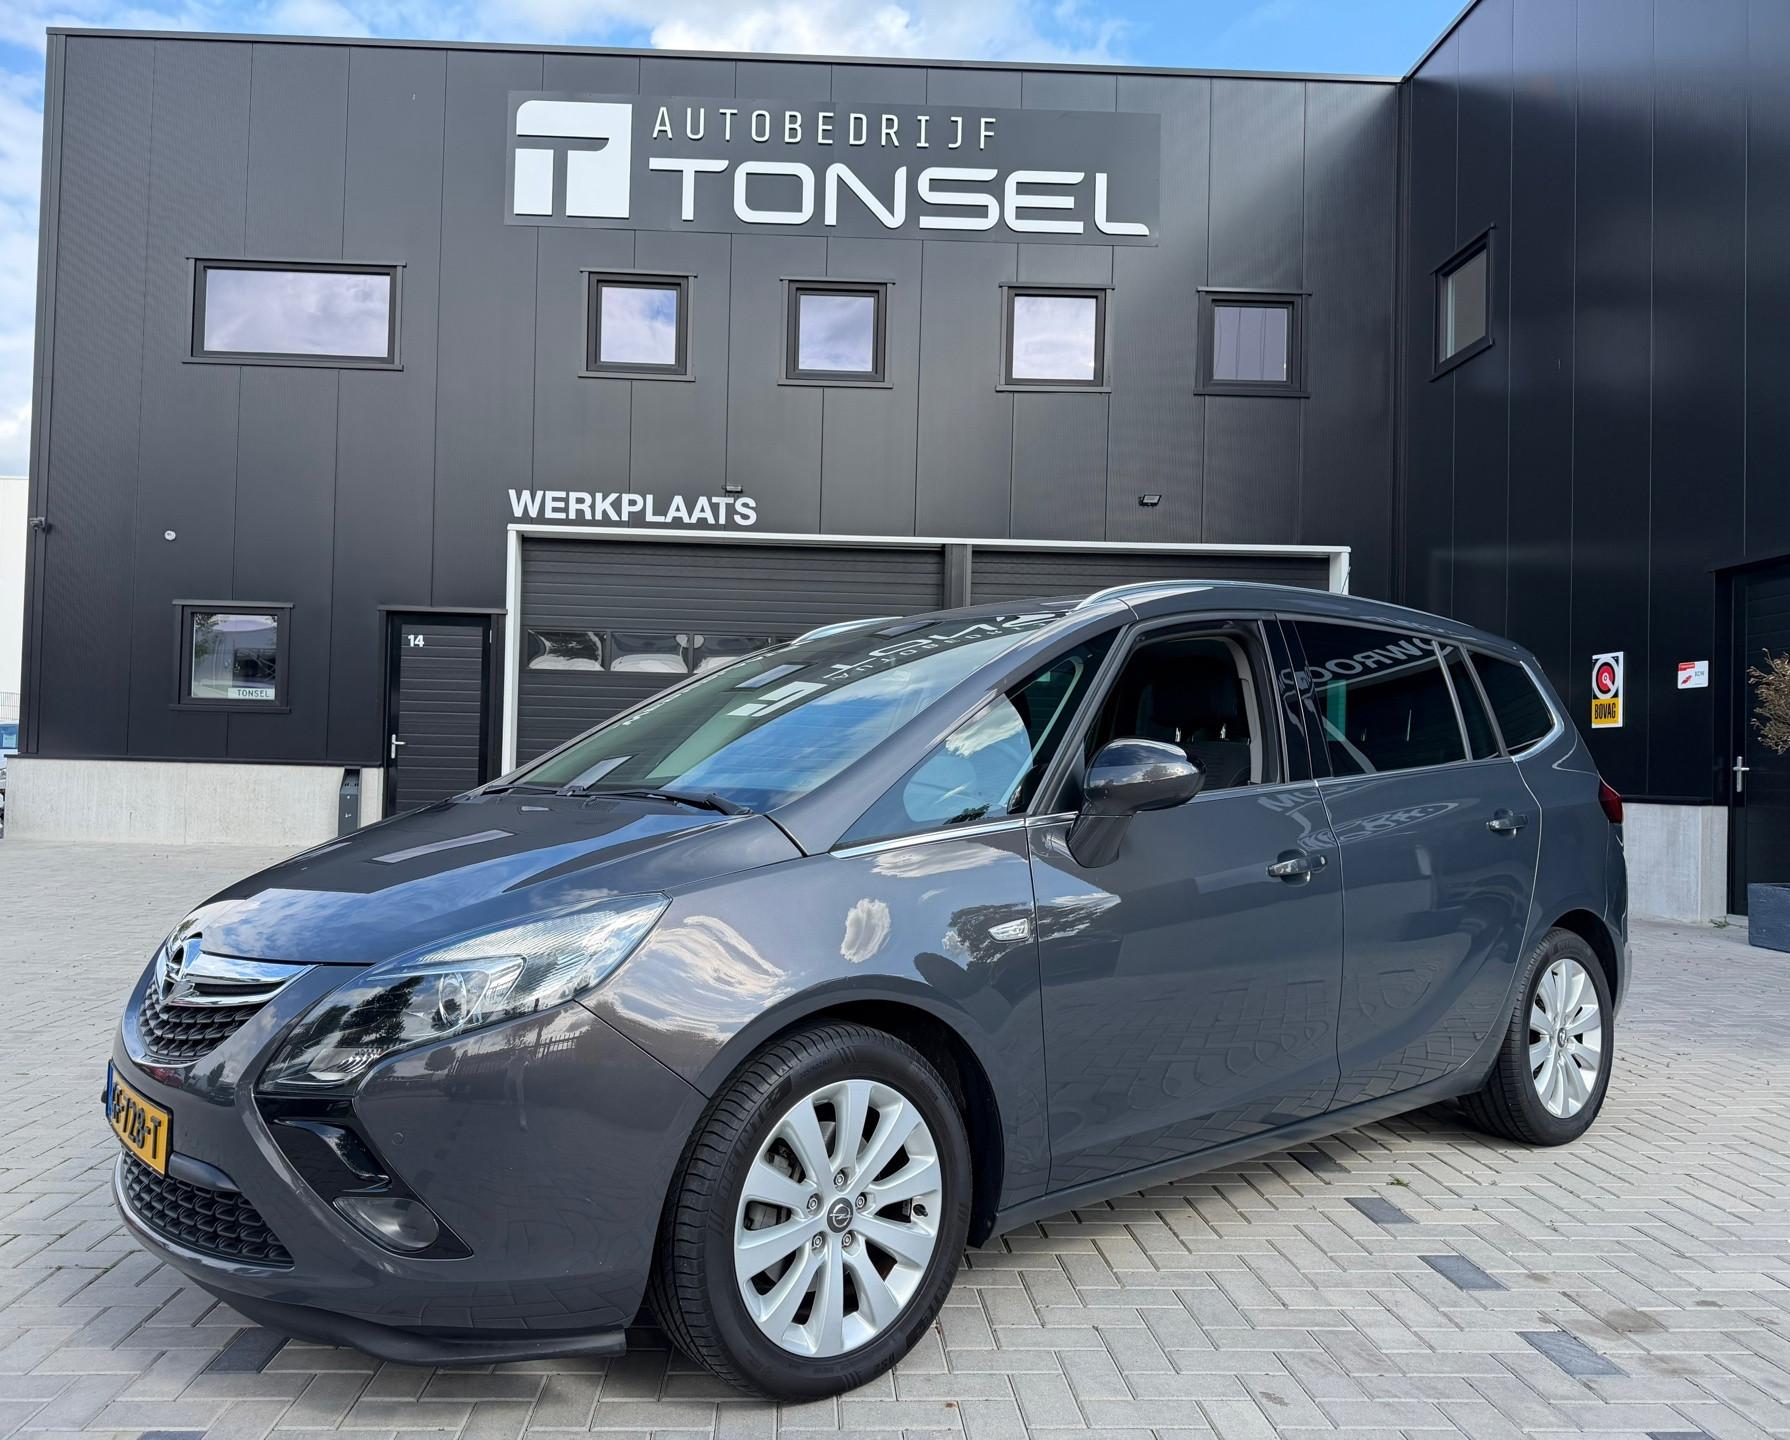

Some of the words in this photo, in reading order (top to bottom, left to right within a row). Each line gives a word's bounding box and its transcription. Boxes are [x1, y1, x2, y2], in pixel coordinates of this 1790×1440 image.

[652, 106, 996, 149] AUTOBEDRIJF
[649, 157, 1149, 236] TONSEL
[508, 489, 757, 526] WERKPLAATS
[407, 634, 425, 648] 14
[236, 688, 270, 698] TONSEL
[1594, 702, 1617, 720] BOVAG
